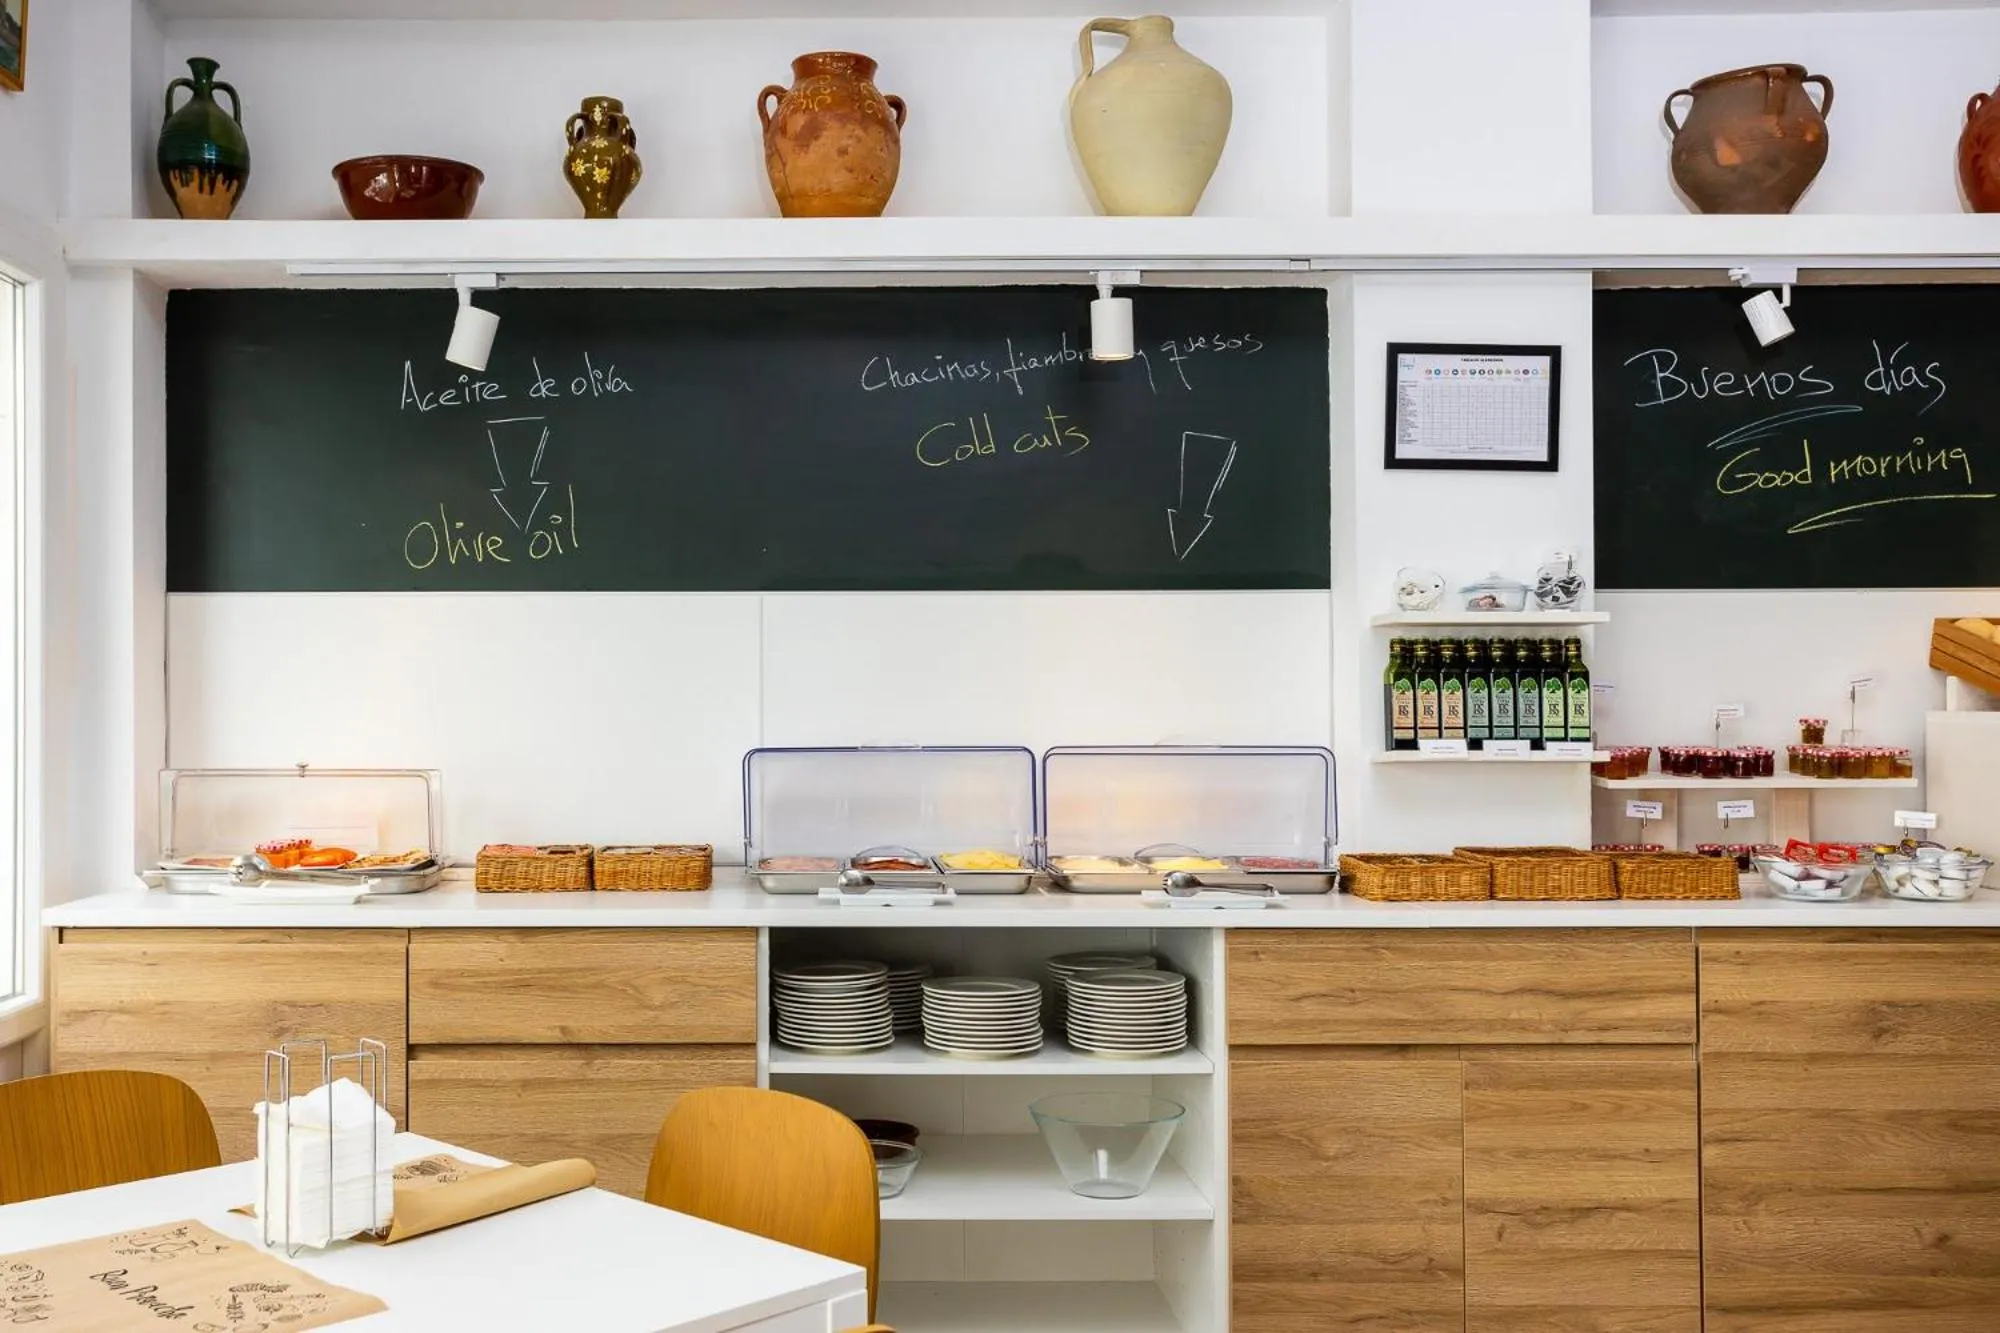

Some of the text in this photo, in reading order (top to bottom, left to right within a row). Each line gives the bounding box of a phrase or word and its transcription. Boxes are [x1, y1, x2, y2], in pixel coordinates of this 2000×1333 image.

[401, 351, 634, 413] Aceite de oliva
[1003, 331, 1106, 396] fiambr
[1160, 333, 1263, 391] quesos
[1624, 339, 1946, 416] Buenos días
[916, 405, 1091, 467] Cold cuts
[1716, 437, 1973, 495] Good morning
[404, 484, 578, 569] Olive oil
